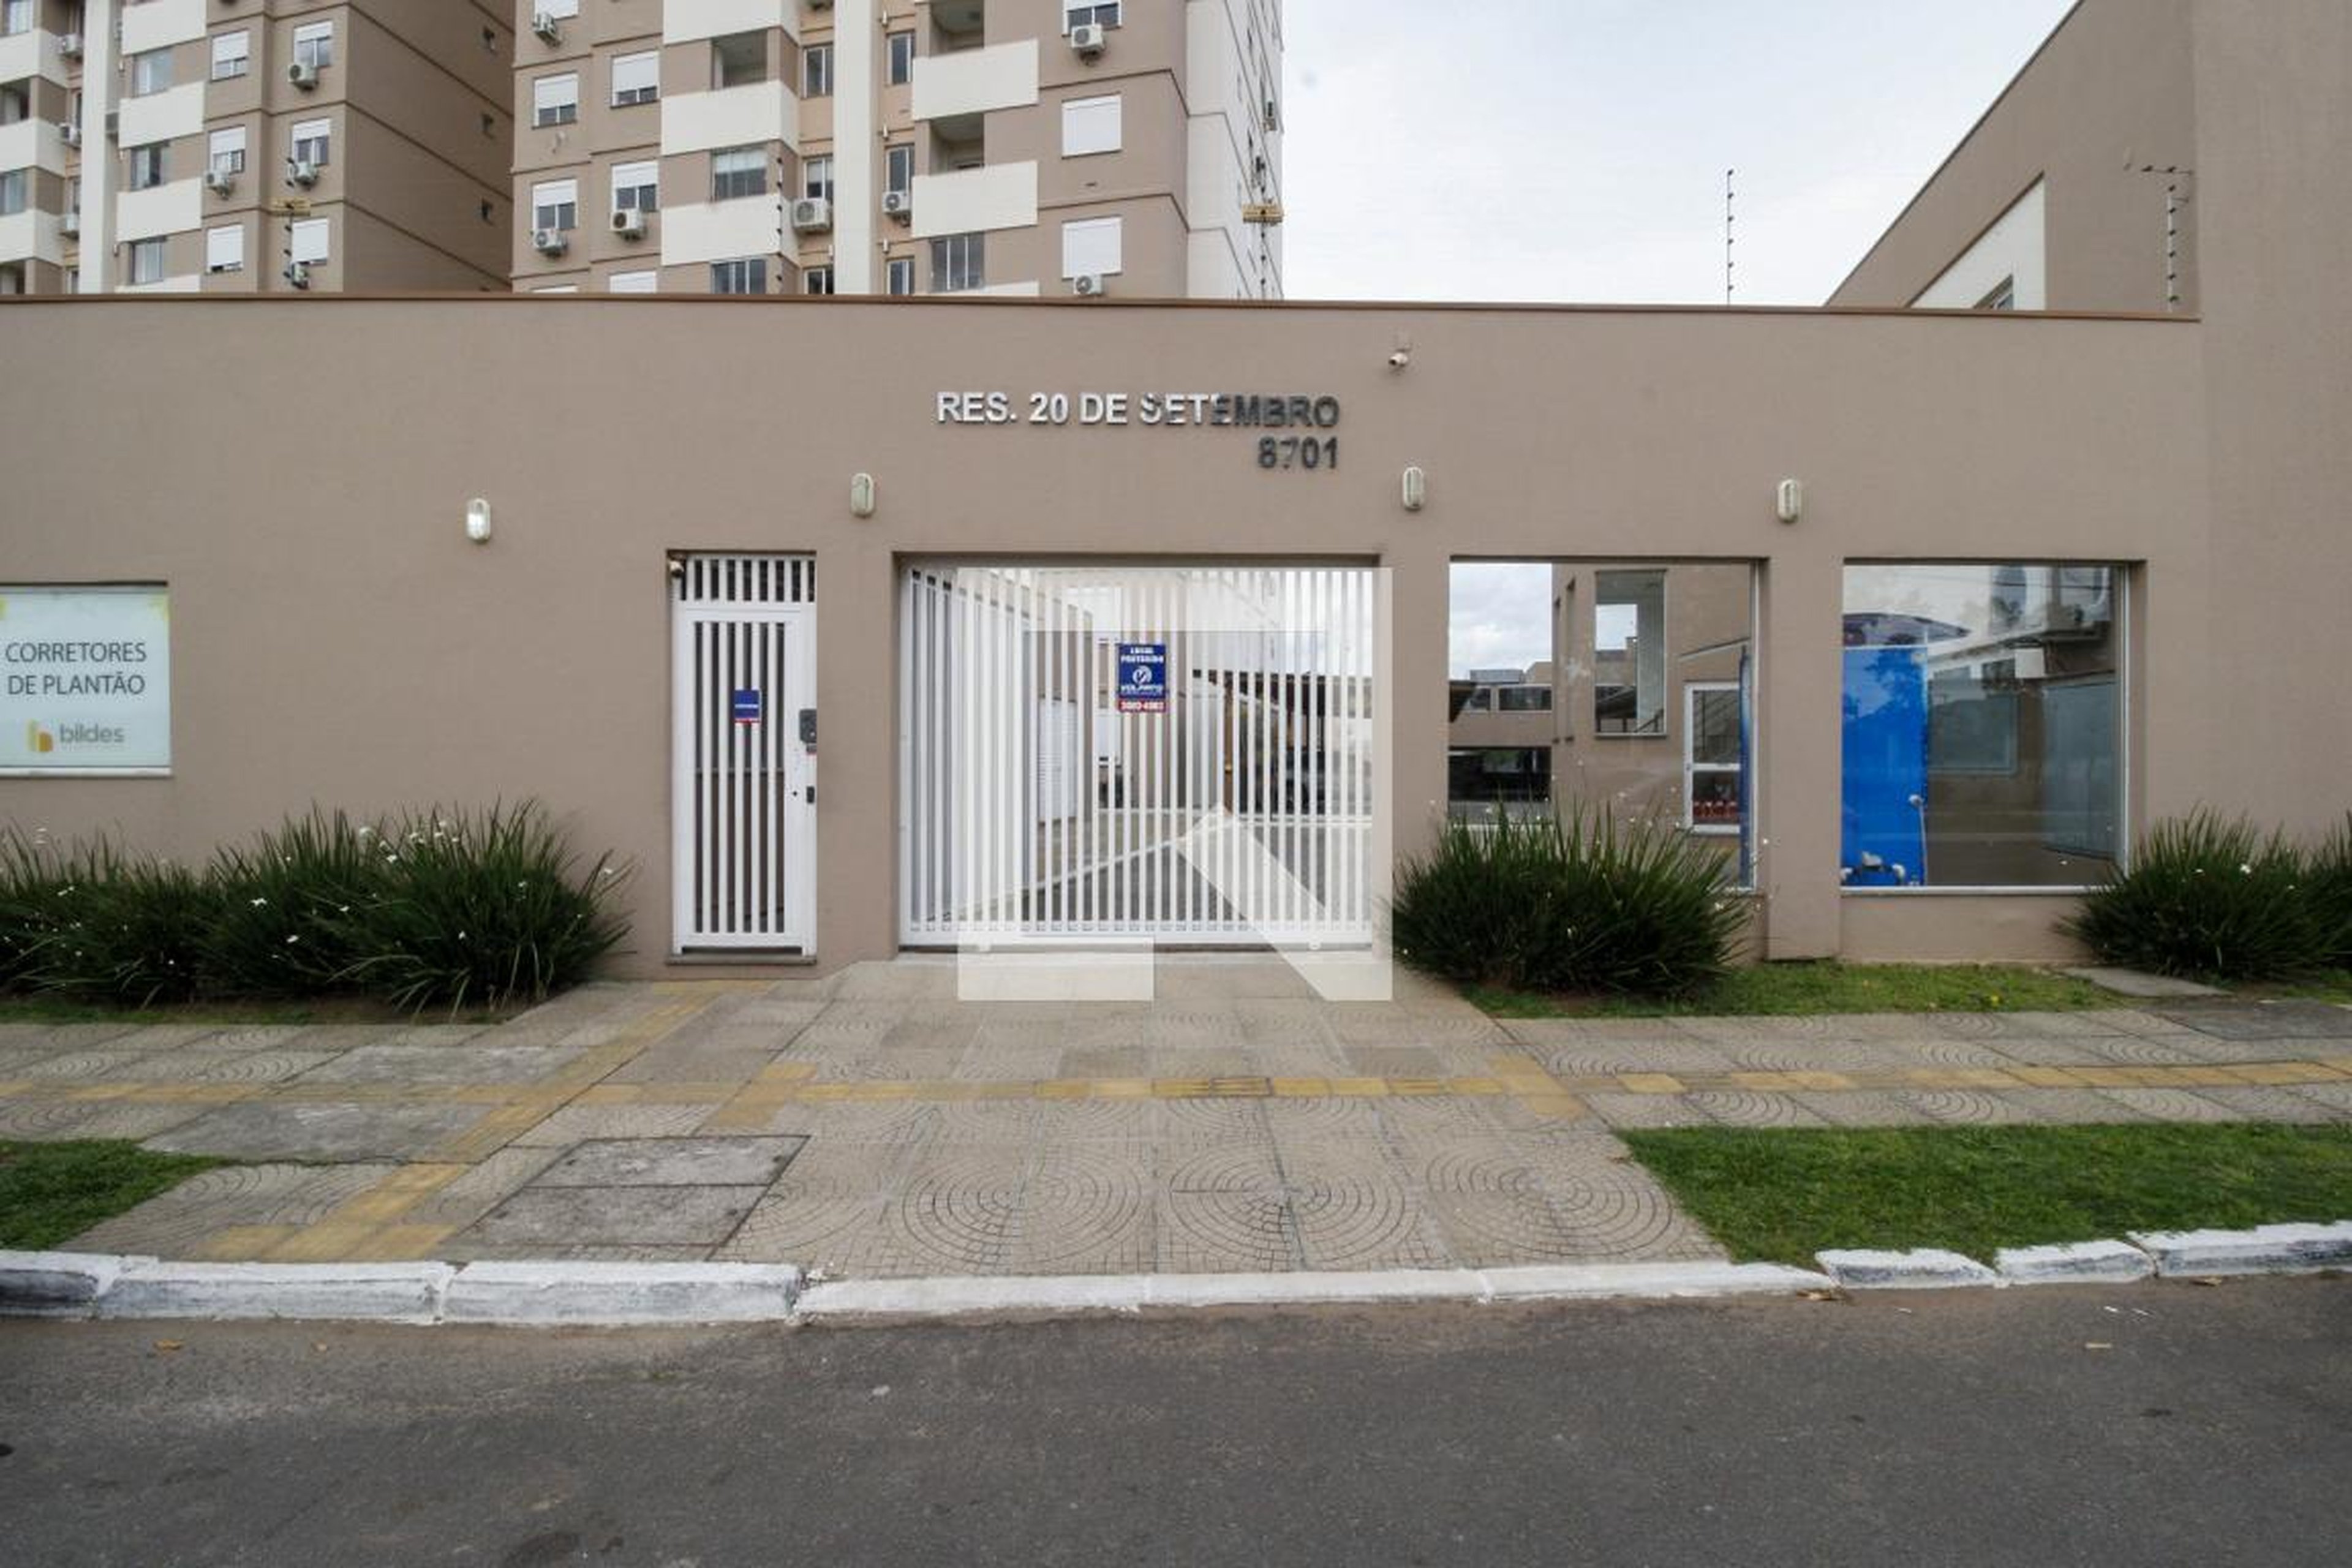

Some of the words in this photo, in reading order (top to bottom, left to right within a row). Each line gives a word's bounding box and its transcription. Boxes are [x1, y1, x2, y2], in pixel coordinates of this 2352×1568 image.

[937, 391, 1017, 425] RES.
[1029, 392, 1069, 426] 20
[1080, 393, 1128, 426] DE
[1140, 393, 1340, 428] SETEMBRO
[1258, 436, 1339, 469] 8701
[5, 642, 147, 663] CORRETORES
[8, 675, 37, 695] DE
[43, 671, 146, 695] PLANTÃO
